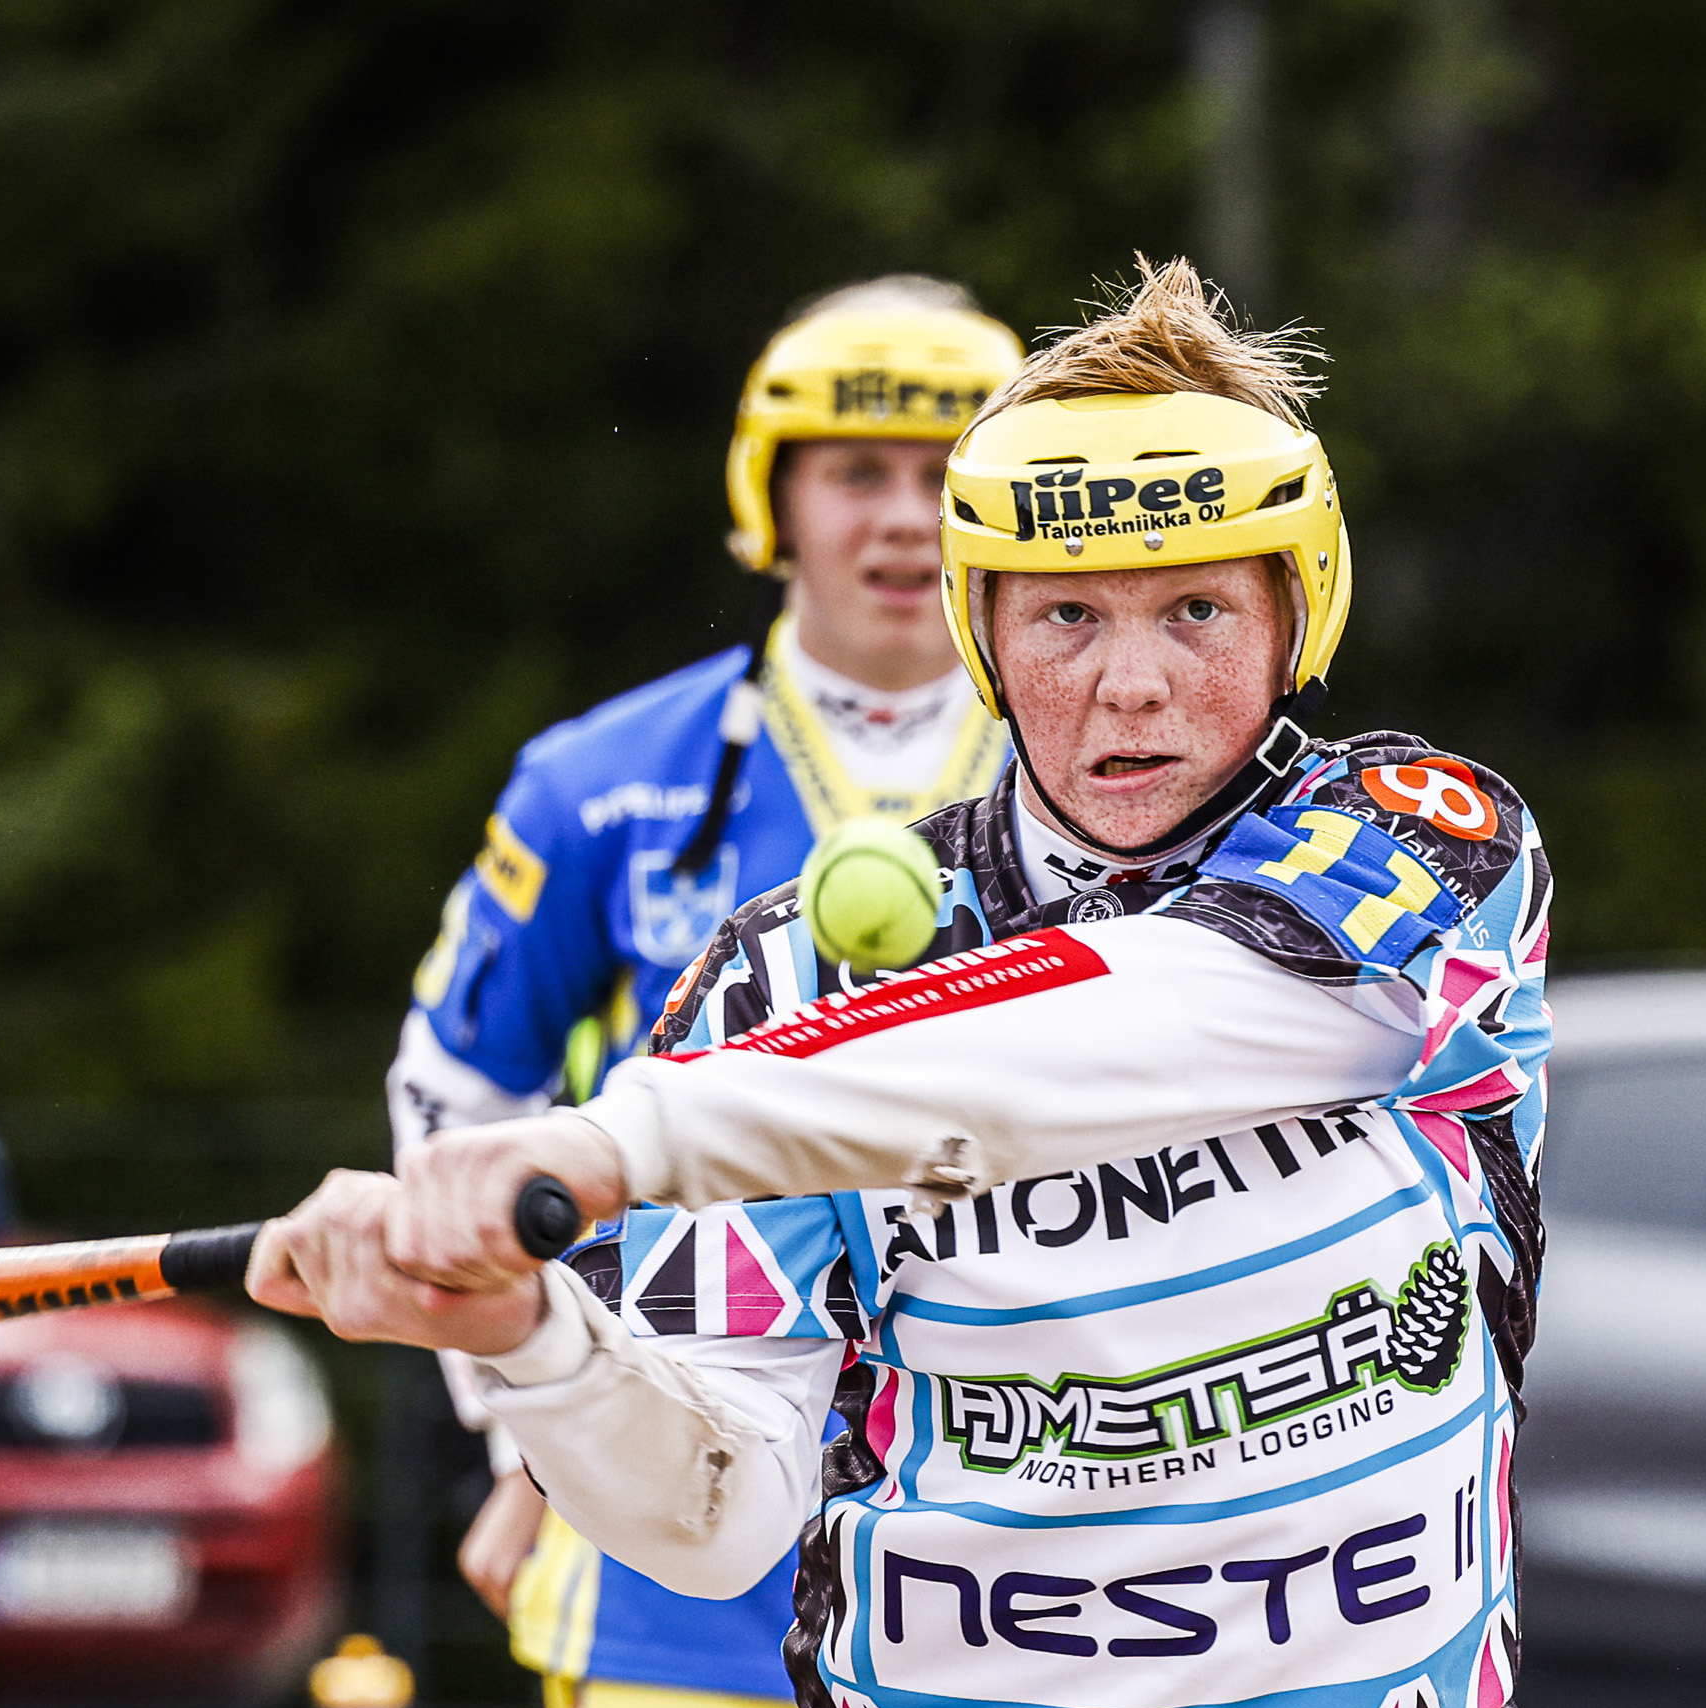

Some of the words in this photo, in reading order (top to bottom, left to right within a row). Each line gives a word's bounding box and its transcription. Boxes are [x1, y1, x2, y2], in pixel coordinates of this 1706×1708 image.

[1037, 511, 1192, 541] Talotekniikka
[1198, 501, 1226, 523] Oy
[947, 954, 1066, 996] tavaratalo
[1019, 1446, 1217, 1491] NORTHERN
[1239, 1388, 1396, 1464] LOGGING
[883, 1512, 1431, 1659] NESTE
